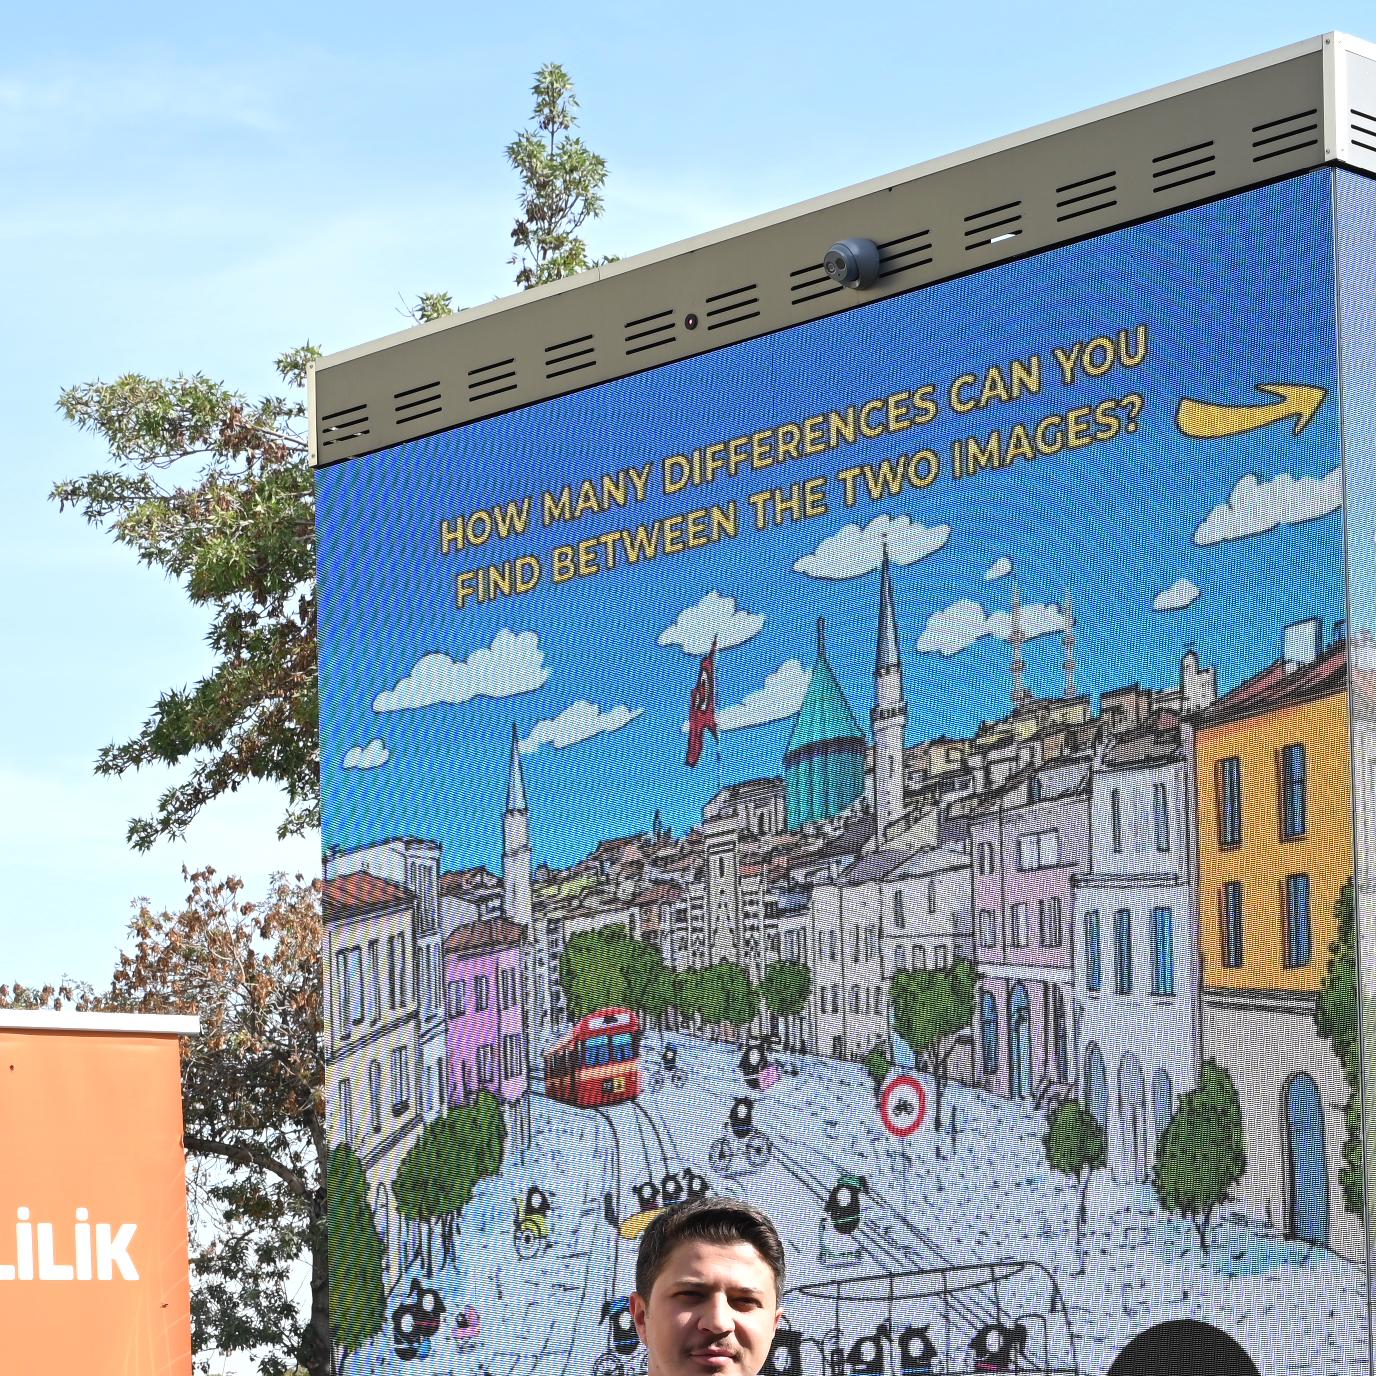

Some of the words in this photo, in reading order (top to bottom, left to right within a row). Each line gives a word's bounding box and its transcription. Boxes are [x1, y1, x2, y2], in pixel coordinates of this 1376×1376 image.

[439, 495, 530, 555] HOW
[541, 462, 649, 525] MANY
[662, 383, 938, 494] DIFFERENCES
[948, 353, 1042, 414] CAN
[1052, 323, 1149, 379] YOU
[454, 552, 541, 609] FIND
[552, 502, 738, 585] BETWEEN
[750, 478, 826, 533] THE
[837, 447, 940, 510] TWO
[951, 391, 1146, 481] IMAGES?
